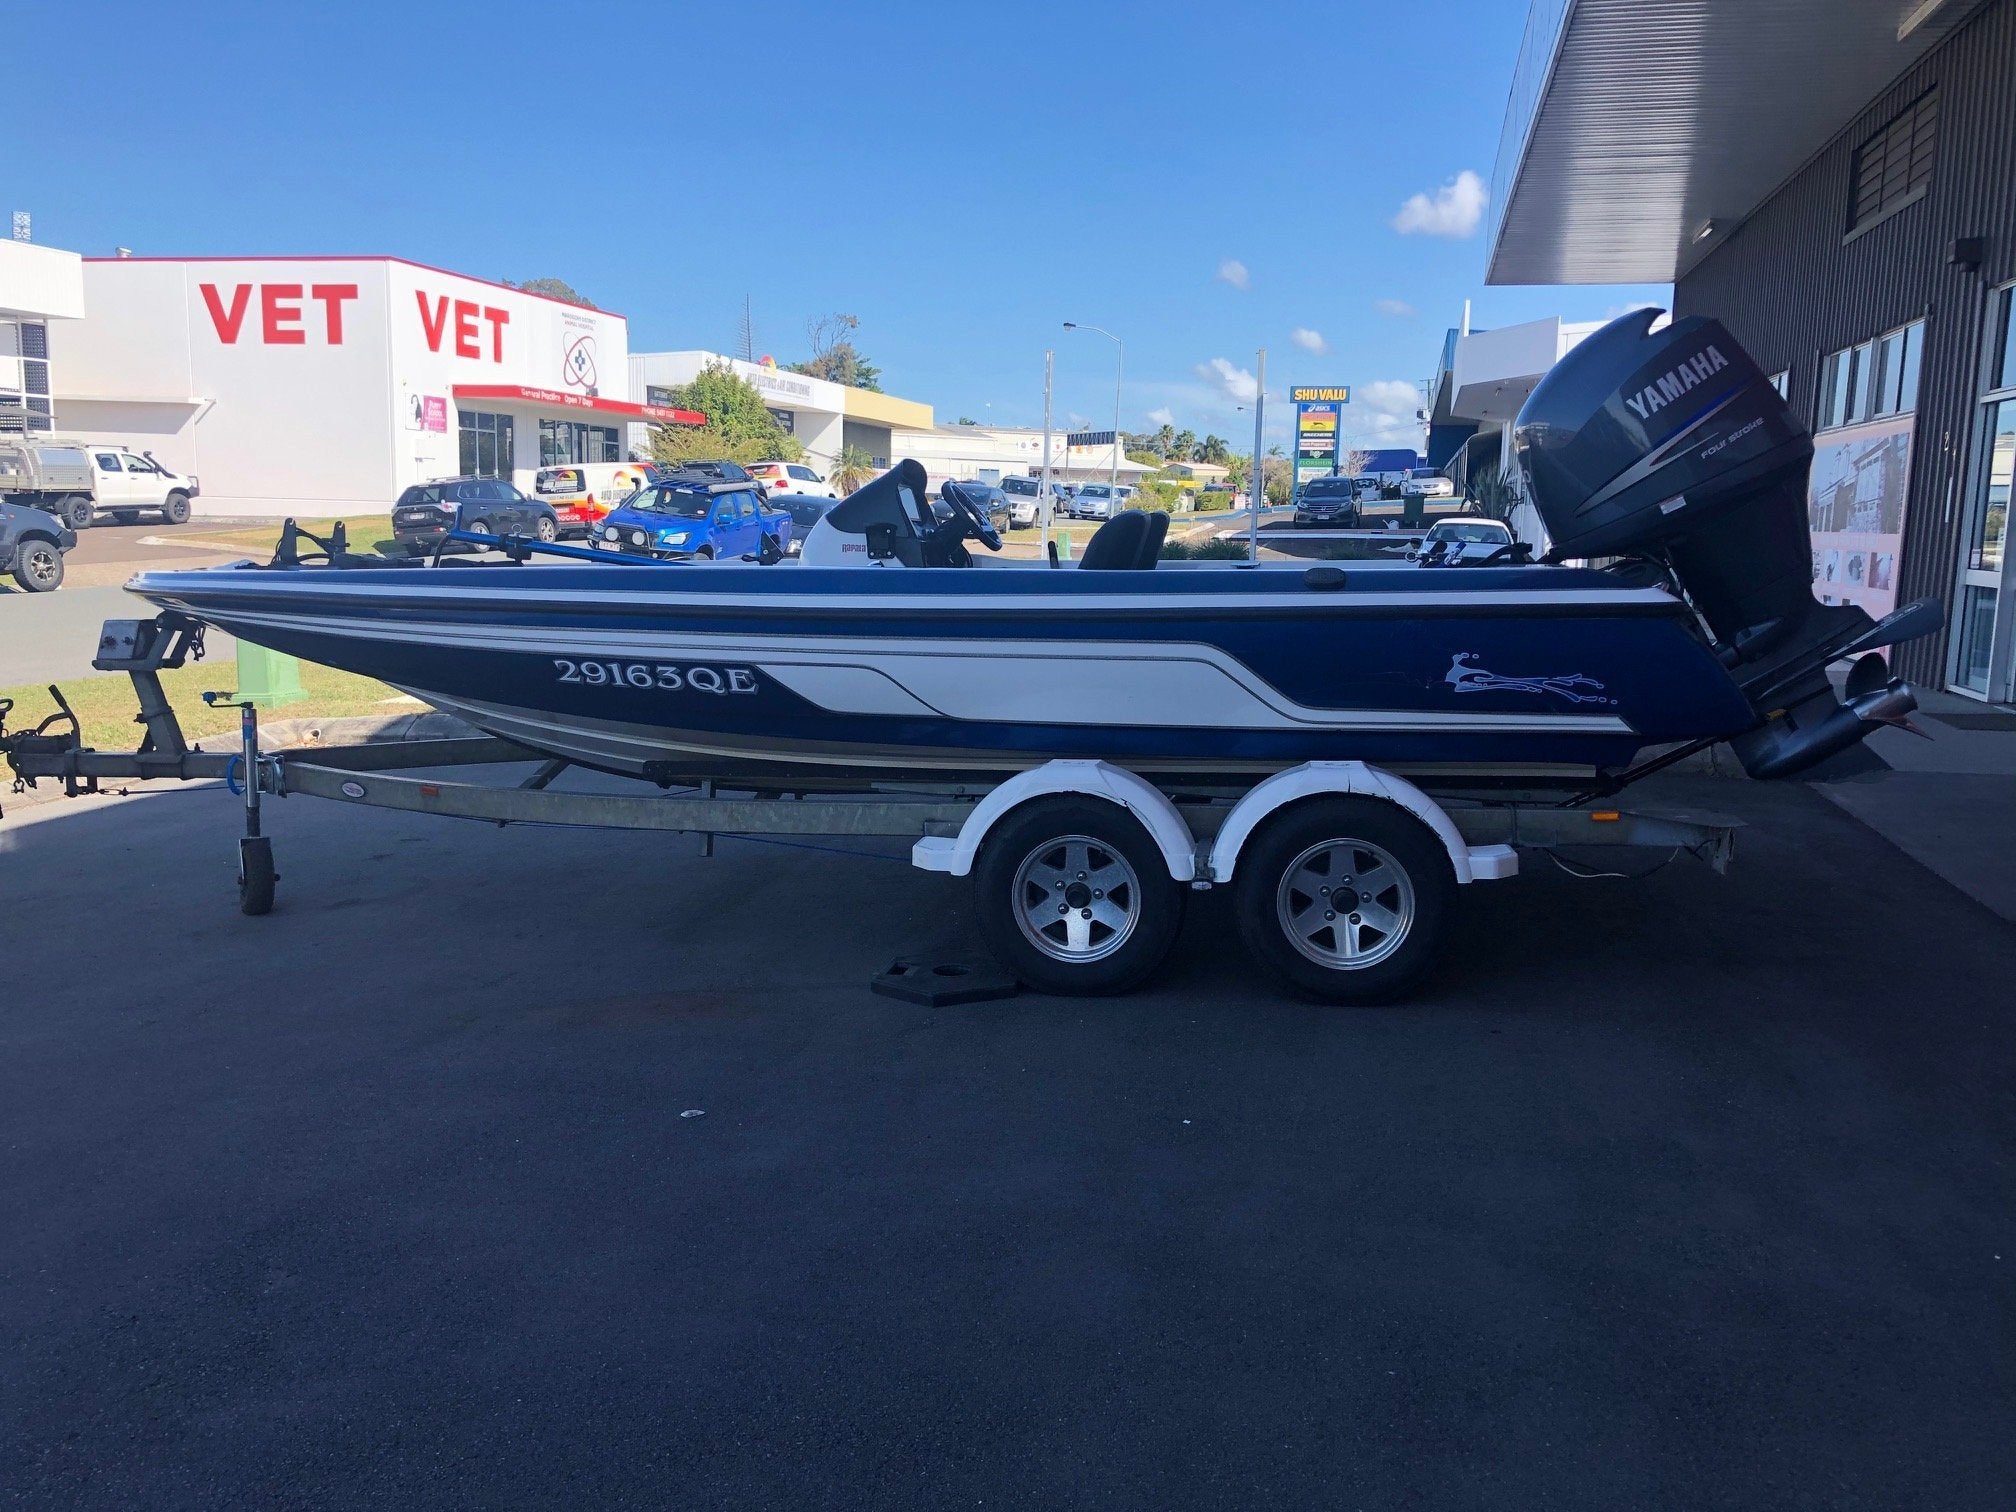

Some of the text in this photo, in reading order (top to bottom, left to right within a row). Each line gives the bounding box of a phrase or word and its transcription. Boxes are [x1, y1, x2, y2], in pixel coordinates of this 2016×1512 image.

[199, 284, 358, 345] VET
[415, 289, 510, 363] VET
[564, 395, 577, 404] Open
[1295, 389, 1346, 400] SHU VALU
[1626, 344, 1729, 419] YAMAHA
[553, 659, 759, 695] 29163QE
